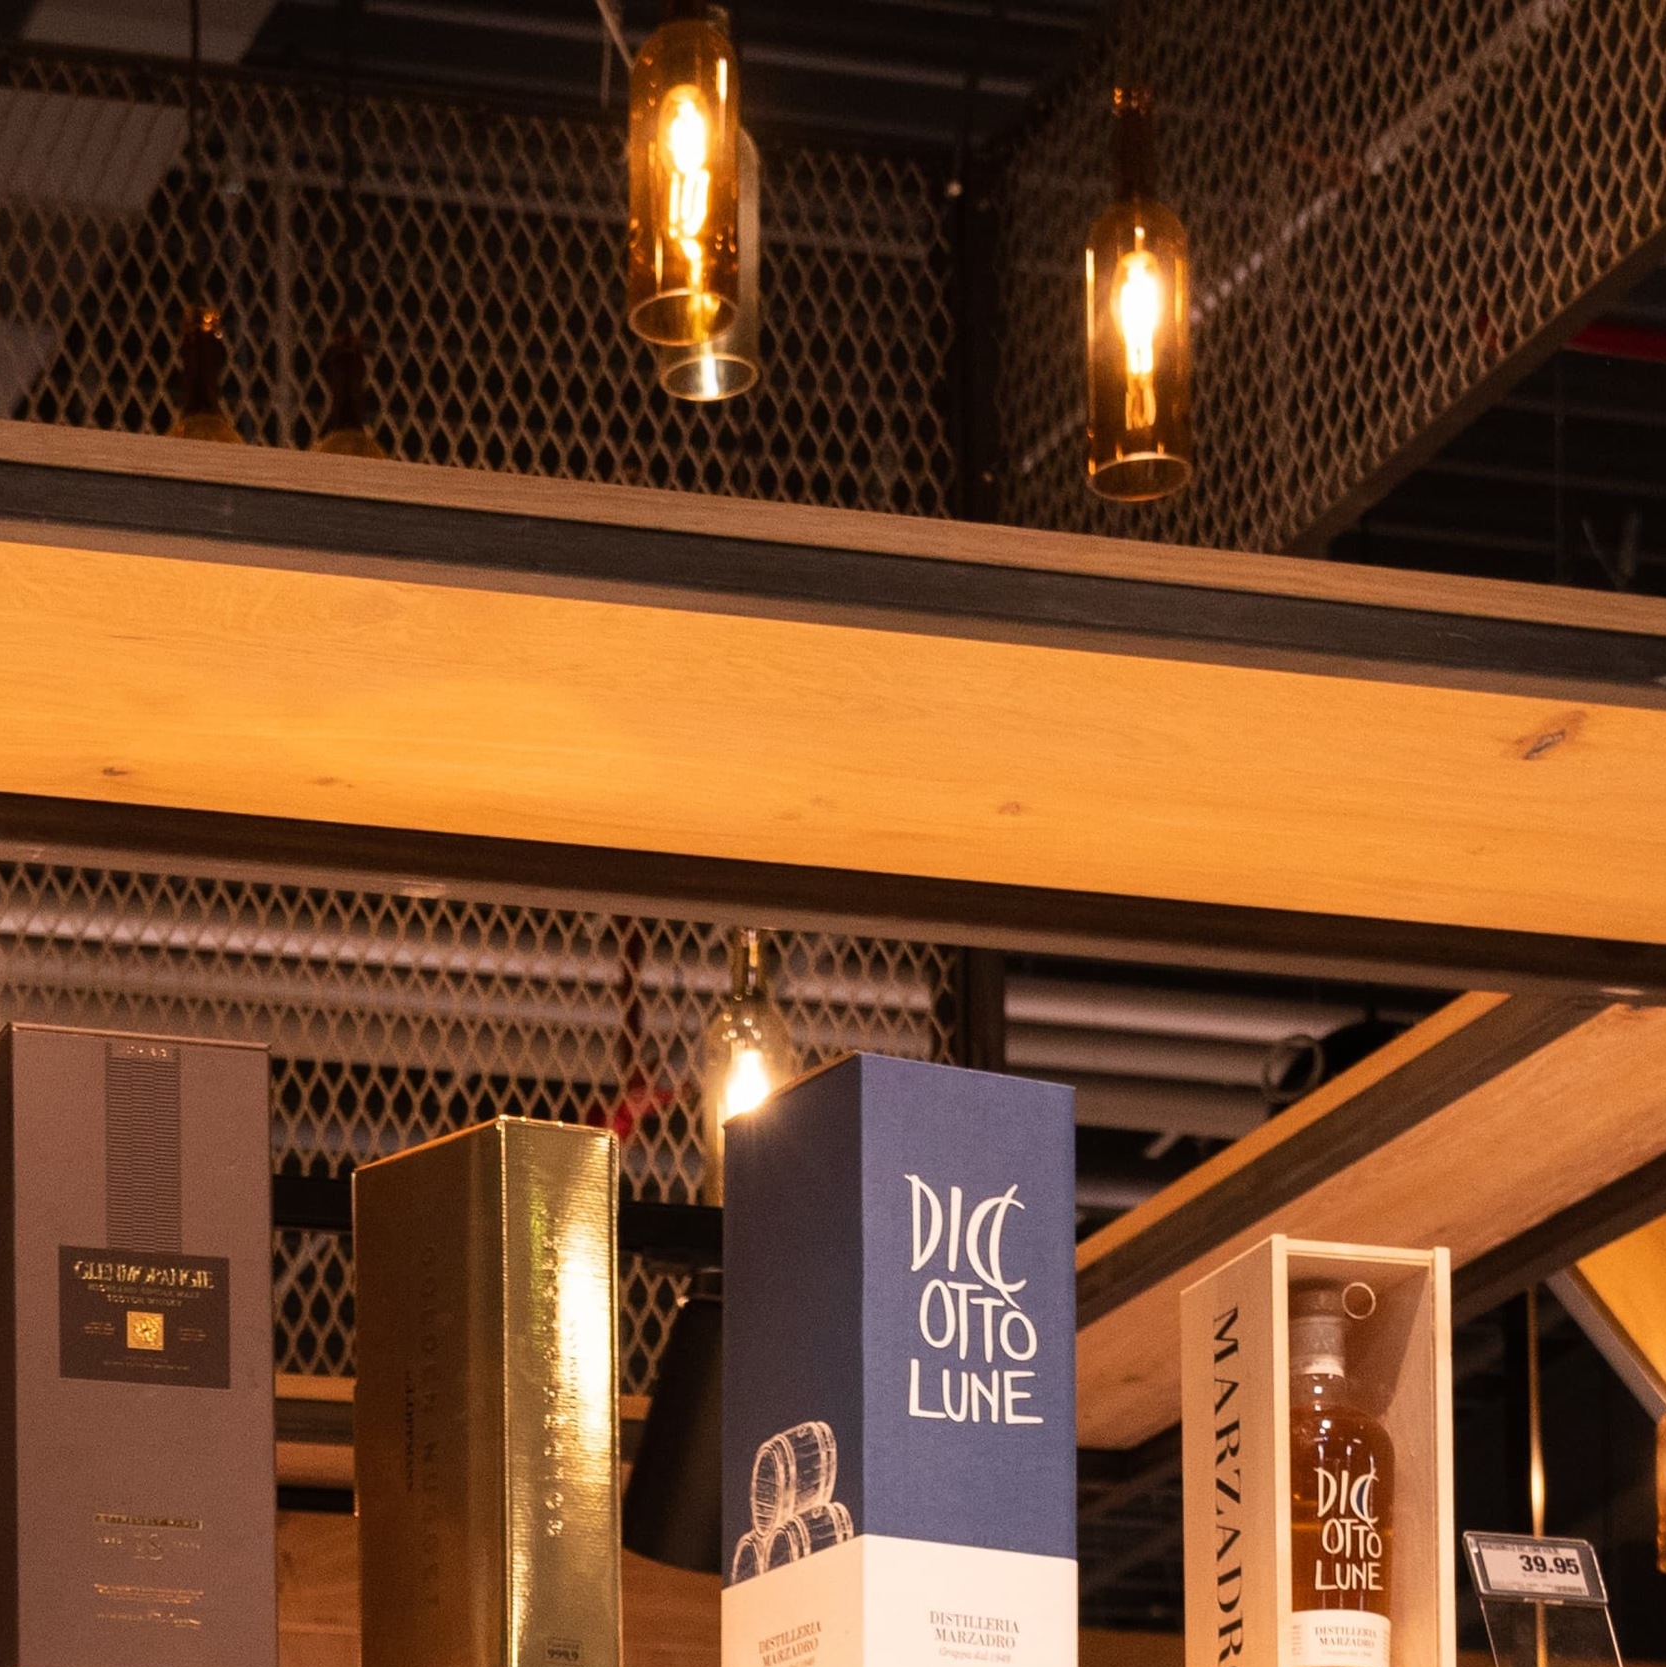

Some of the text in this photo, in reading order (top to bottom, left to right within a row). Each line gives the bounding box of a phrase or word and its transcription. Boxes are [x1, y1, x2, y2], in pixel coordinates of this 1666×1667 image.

[919, 1280, 1037, 1364] OTTO
[908, 1358, 1045, 1426] LUNE
[1322, 1518, 1384, 1560] OTTO
[1315, 1559, 1384, 1591] LUNE
[1519, 1554, 1580, 1576] 39.95
[758, 1620, 823, 1654] DISTILLERIA
[929, 1610, 1020, 1635] DISTILLERIA
[935, 1627, 1016, 1650] MARZADRO
